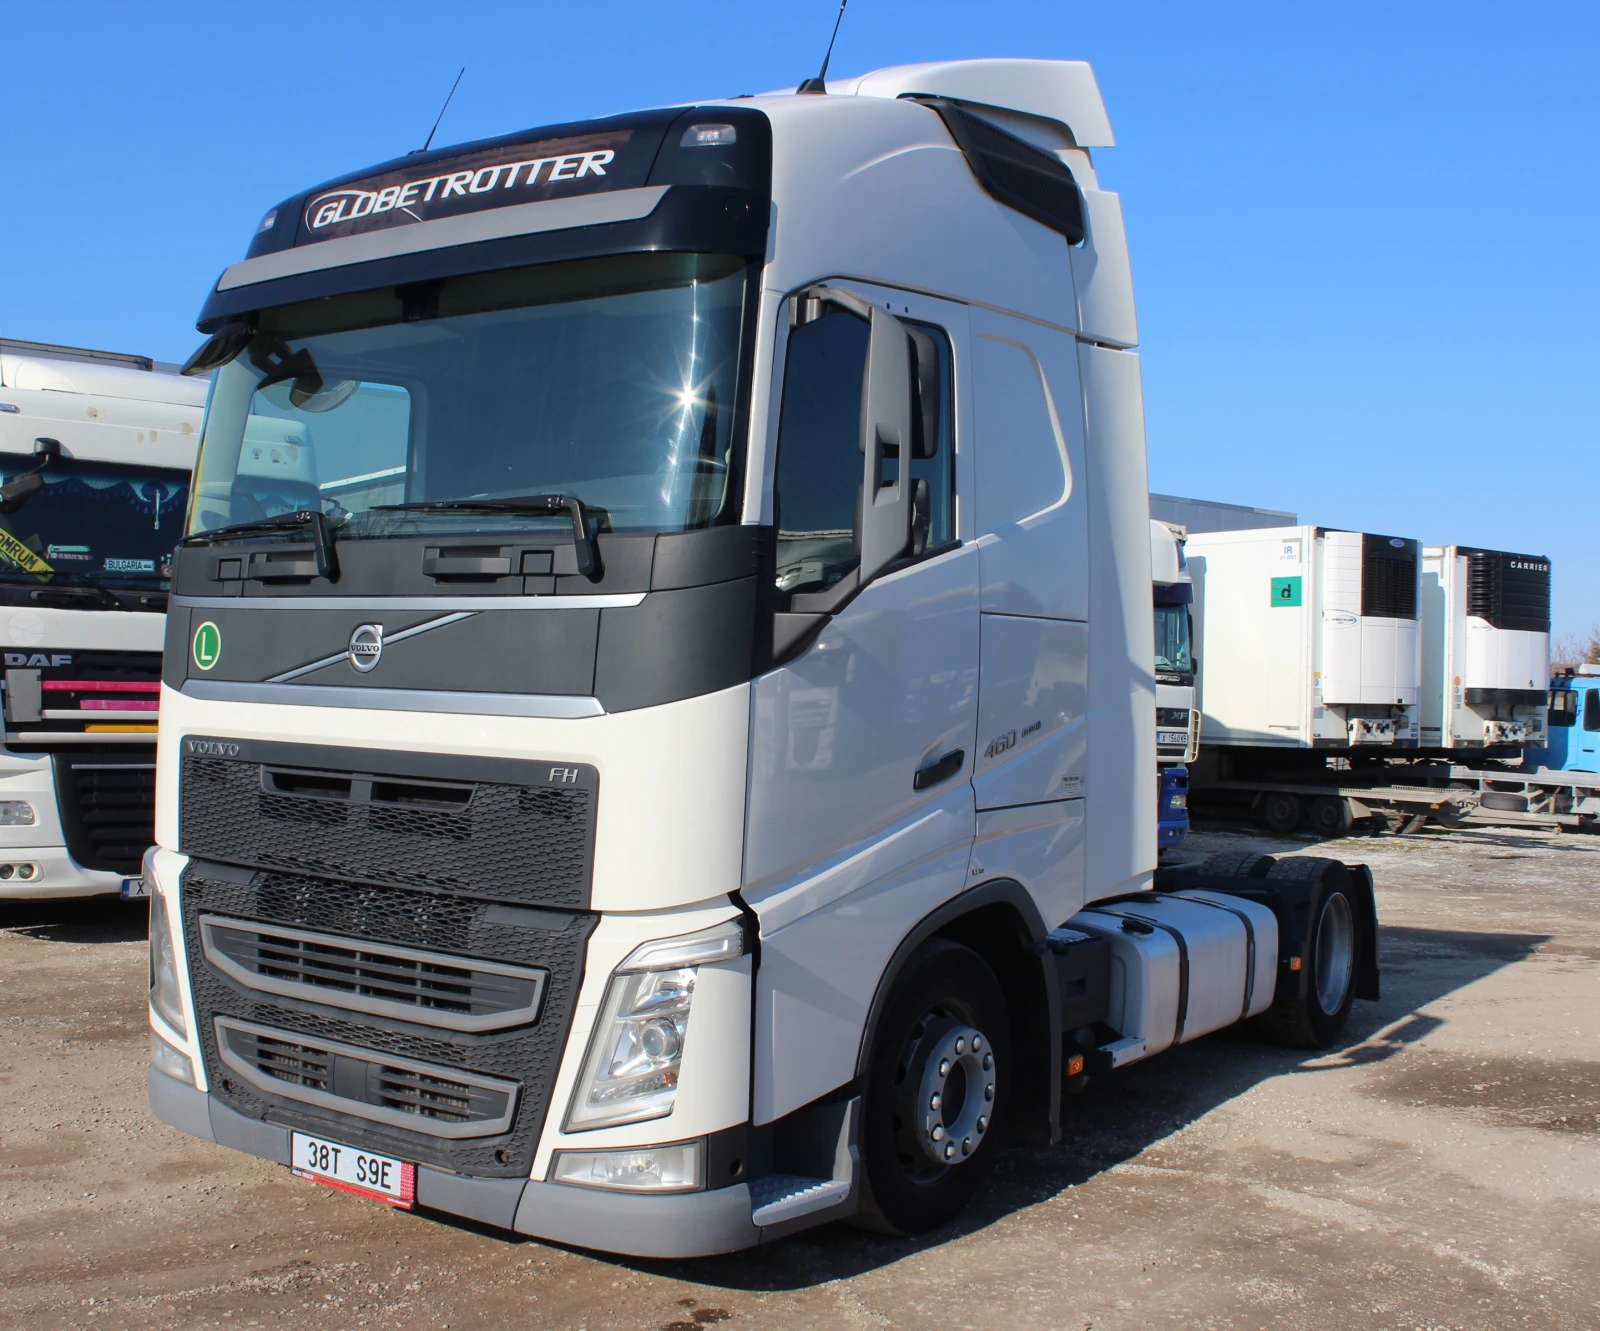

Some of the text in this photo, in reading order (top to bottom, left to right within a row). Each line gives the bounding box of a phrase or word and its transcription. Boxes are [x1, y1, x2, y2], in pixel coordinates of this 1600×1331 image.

[313, 149, 615, 229] GLOBETROTTER
[1283, 545, 1293, 555] IR
[108, 559, 143, 570] BULGARIA
[1510, 561, 1548, 571] CARRIER
[201, 631, 213, 660] L
[350, 644, 380, 652] VOLVO
[4, 653, 72, 667] DAF
[1171, 711, 1188, 720] XF
[186, 740, 240, 757] VOLVO
[984, 728, 1017, 758] 460
[548, 767, 579, 784] FH
[136, 881, 145, 895] X
[308, 1141, 342, 1174] 38T
[356, 1155, 392, 1190] S9E
